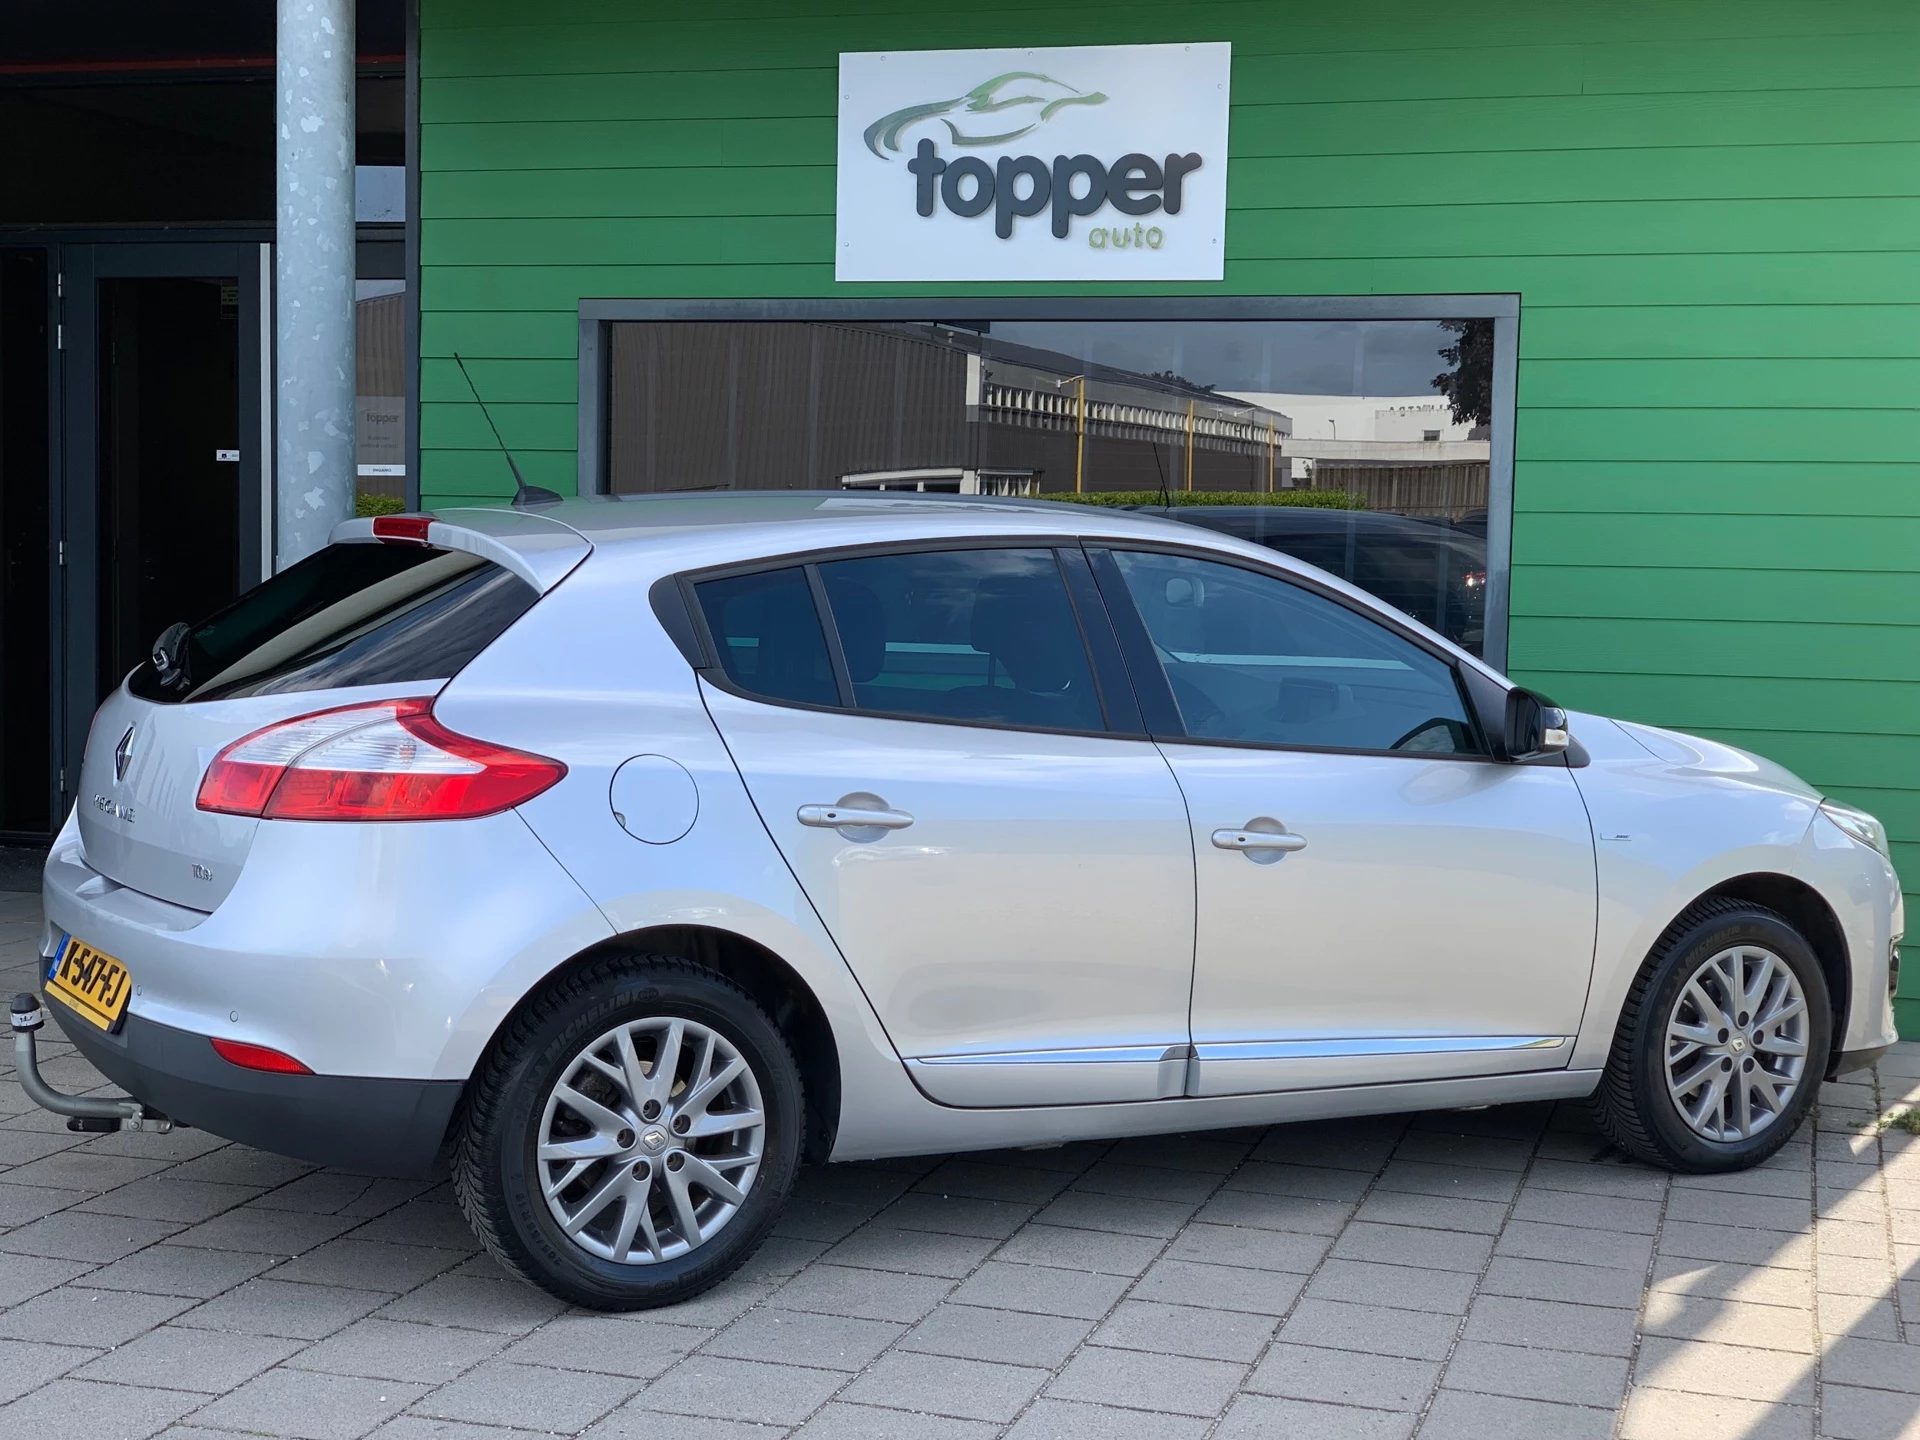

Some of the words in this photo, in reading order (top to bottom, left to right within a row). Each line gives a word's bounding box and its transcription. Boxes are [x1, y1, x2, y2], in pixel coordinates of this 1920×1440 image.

[907, 138, 1203, 239] topper
[1088, 222, 1164, 249] auto
[366, 412, 400, 425] topper
[60, 941, 127, 1007] K-547-FJ
[544, 989, 636, 1060] MICHELIN
